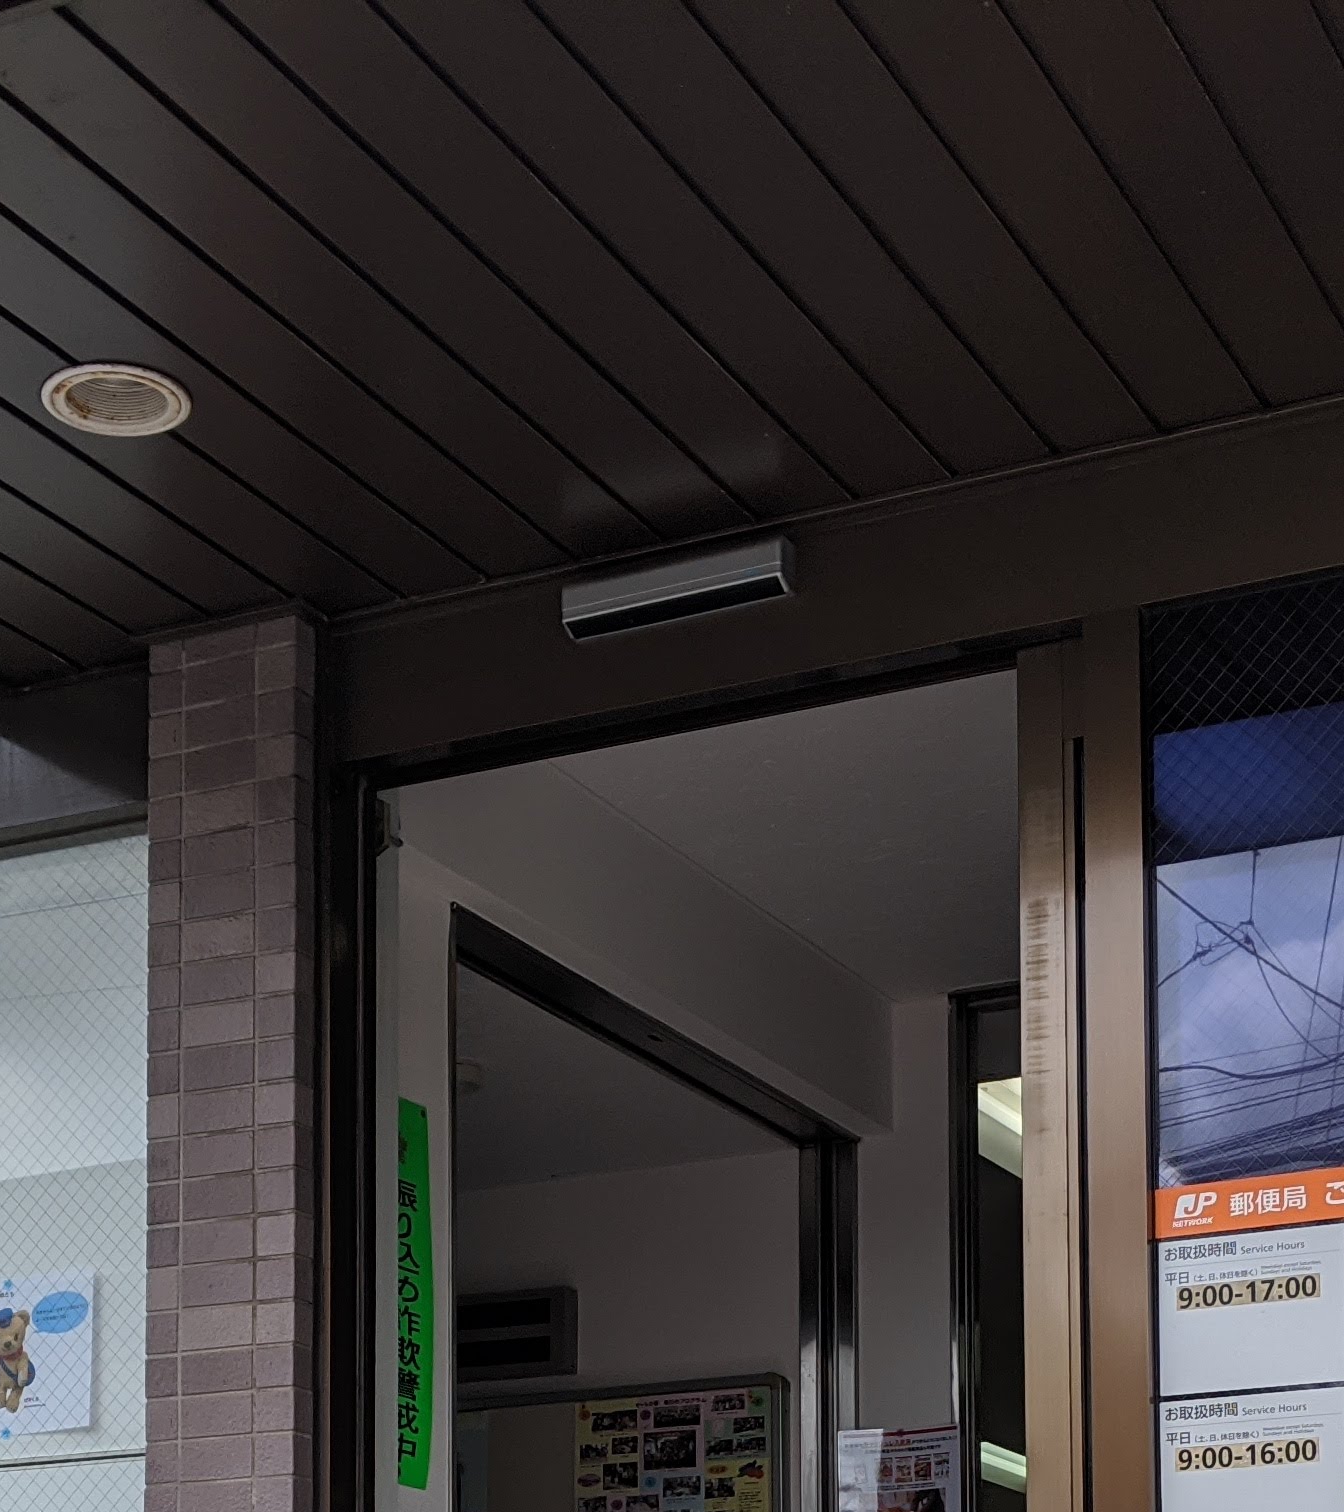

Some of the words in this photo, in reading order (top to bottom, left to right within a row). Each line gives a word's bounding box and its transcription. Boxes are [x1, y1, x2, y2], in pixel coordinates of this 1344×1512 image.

[1230, 1186, 1307, 1216] 郵便局
[1172, 1217, 1214, 1228] NETWORK
[1164, 1241, 1237, 1262] お取扱時間
[1240, 1243, 1274, 1256] Service
[1276, 1240, 1305, 1251] Hours
[1165, 1272, 1190, 1287] 平日
[1178, 1275, 1317, 1310] 9:00-17:00
[1164, 1402, 1238, 1422] お取扱時間
[1242, 1404, 1276, 1417] Service
[1278, 1402, 1307, 1413] Hours
[1166, 1431, 1191, 1445] 平日
[1177, 1438, 1318, 1471] 9:00-16:00
